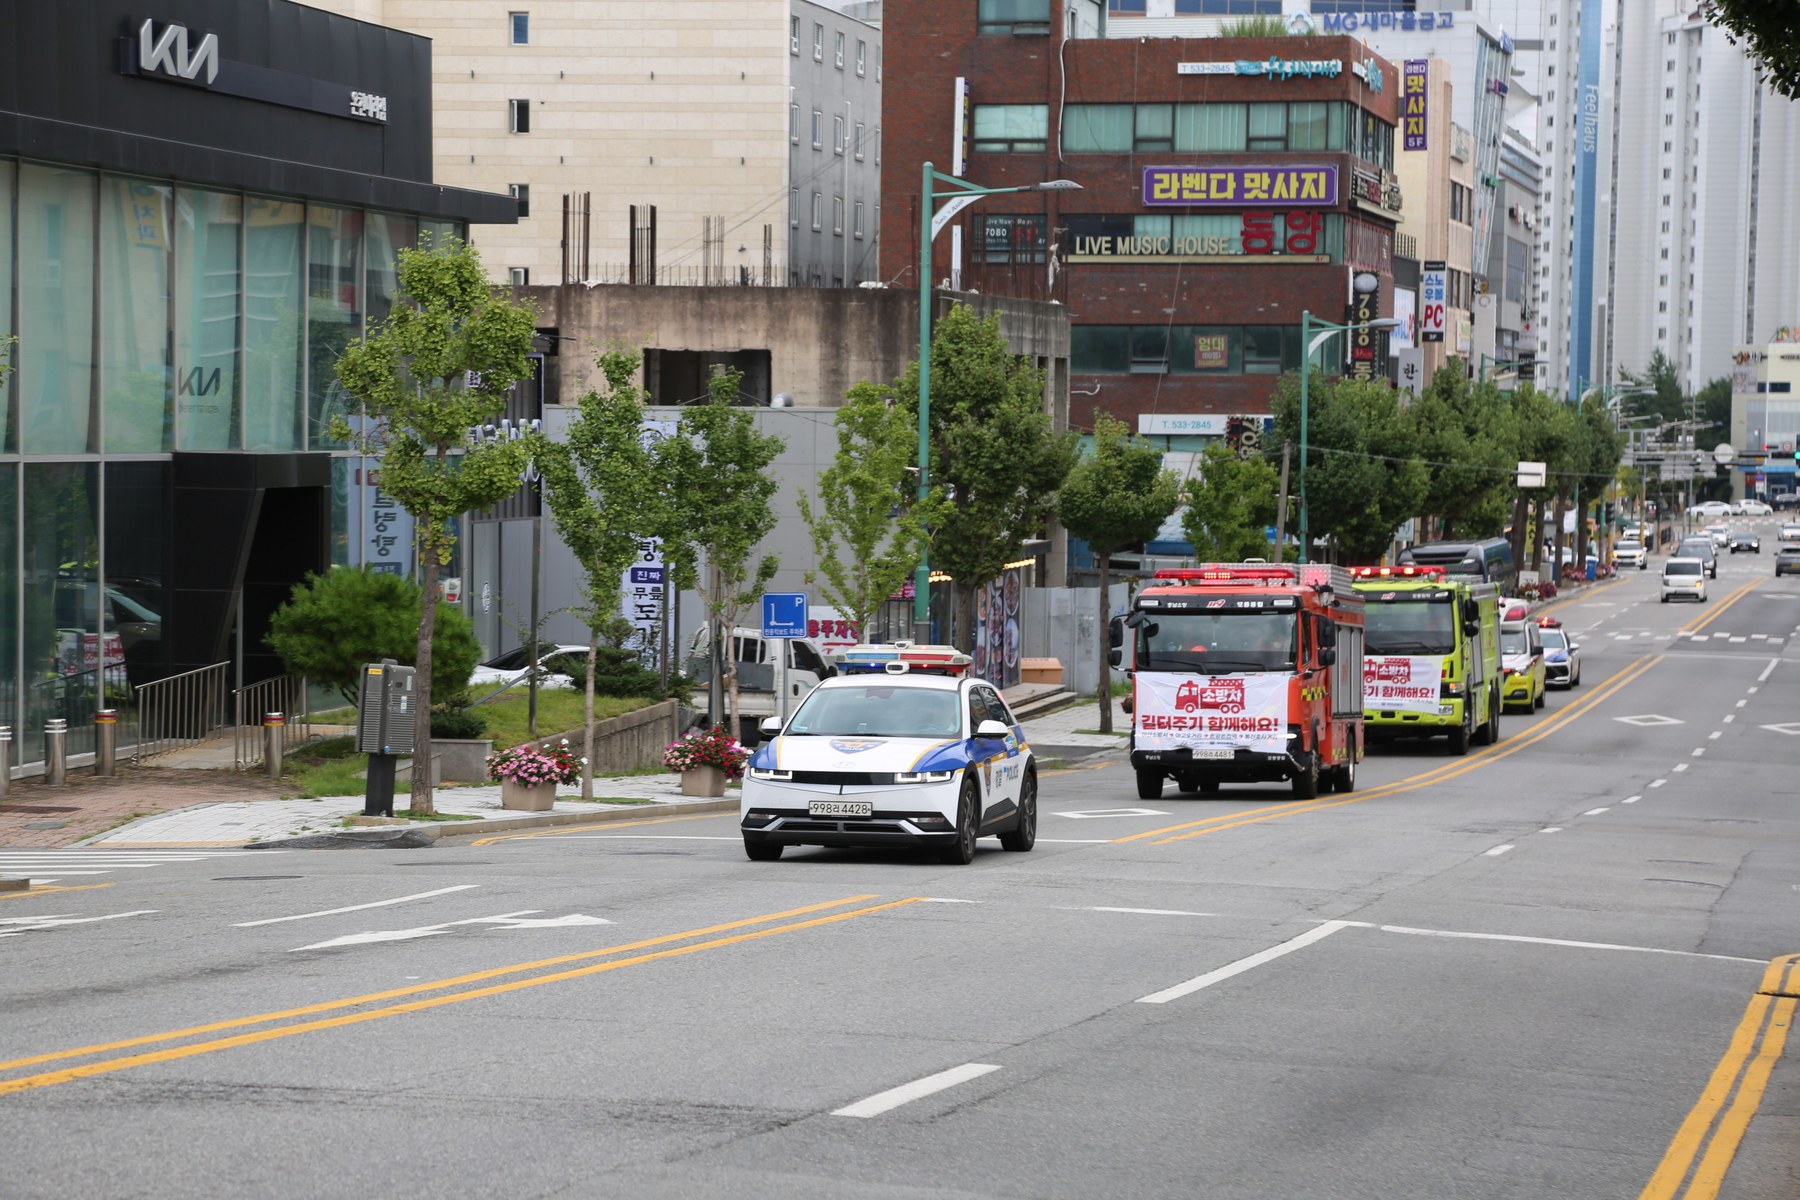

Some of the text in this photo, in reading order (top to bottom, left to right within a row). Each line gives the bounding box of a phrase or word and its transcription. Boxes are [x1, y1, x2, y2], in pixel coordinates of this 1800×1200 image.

[1190, 64, 1231, 73] 533-2845
[1406, 64, 1426, 74] 라벤다
[1407, 75, 1425, 135] 맛사지
[1583, 84, 1599, 154] Feelhaus
[1153, 172, 1237, 200] 라벤다
[1243, 172, 1326, 200] 맛사지
[1240, 211, 1323, 255] 동양
[1075, 236, 1229, 256] LIVE MUSIC HOUSE
[1423, 304, 1444, 329] PC
[1198, 337, 1225, 352] 임대
[1171, 420, 1212, 430] 533-2845
[637, 570, 662, 581] 진짜
[633, 586, 664, 600] 무릎
[795, 597, 803, 607] P
[1379, 665, 1409, 676] 소방차
[1202, 688, 1242, 703] 소방차
[1382, 685, 1435, 699] 함께해요!
[1141, 714, 1279, 732] 길터주기 함께해요!
[841, 803, 868, 815] 4428
